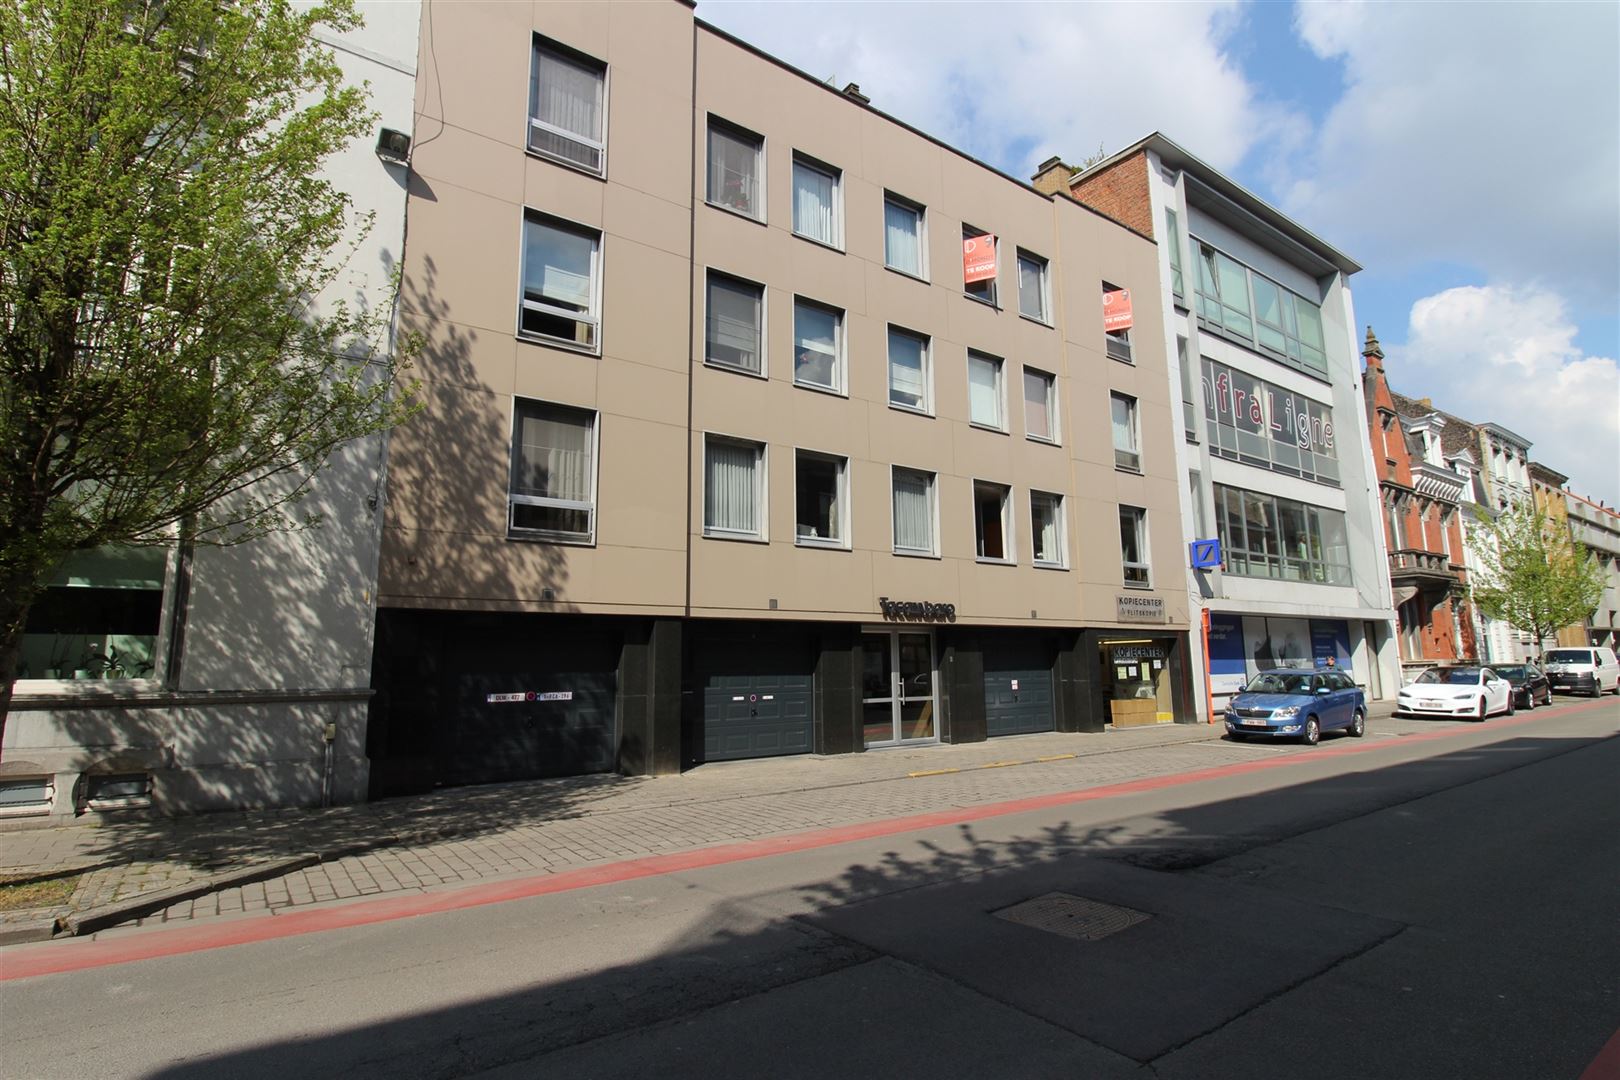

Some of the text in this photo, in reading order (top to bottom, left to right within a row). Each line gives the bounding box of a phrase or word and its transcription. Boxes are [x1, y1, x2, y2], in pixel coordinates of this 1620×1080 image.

[975, 263, 995, 272] KOOP
[1119, 597, 1162, 607] KOPIECENTER
[1114, 647, 1164, 657] KOPIECENTER
